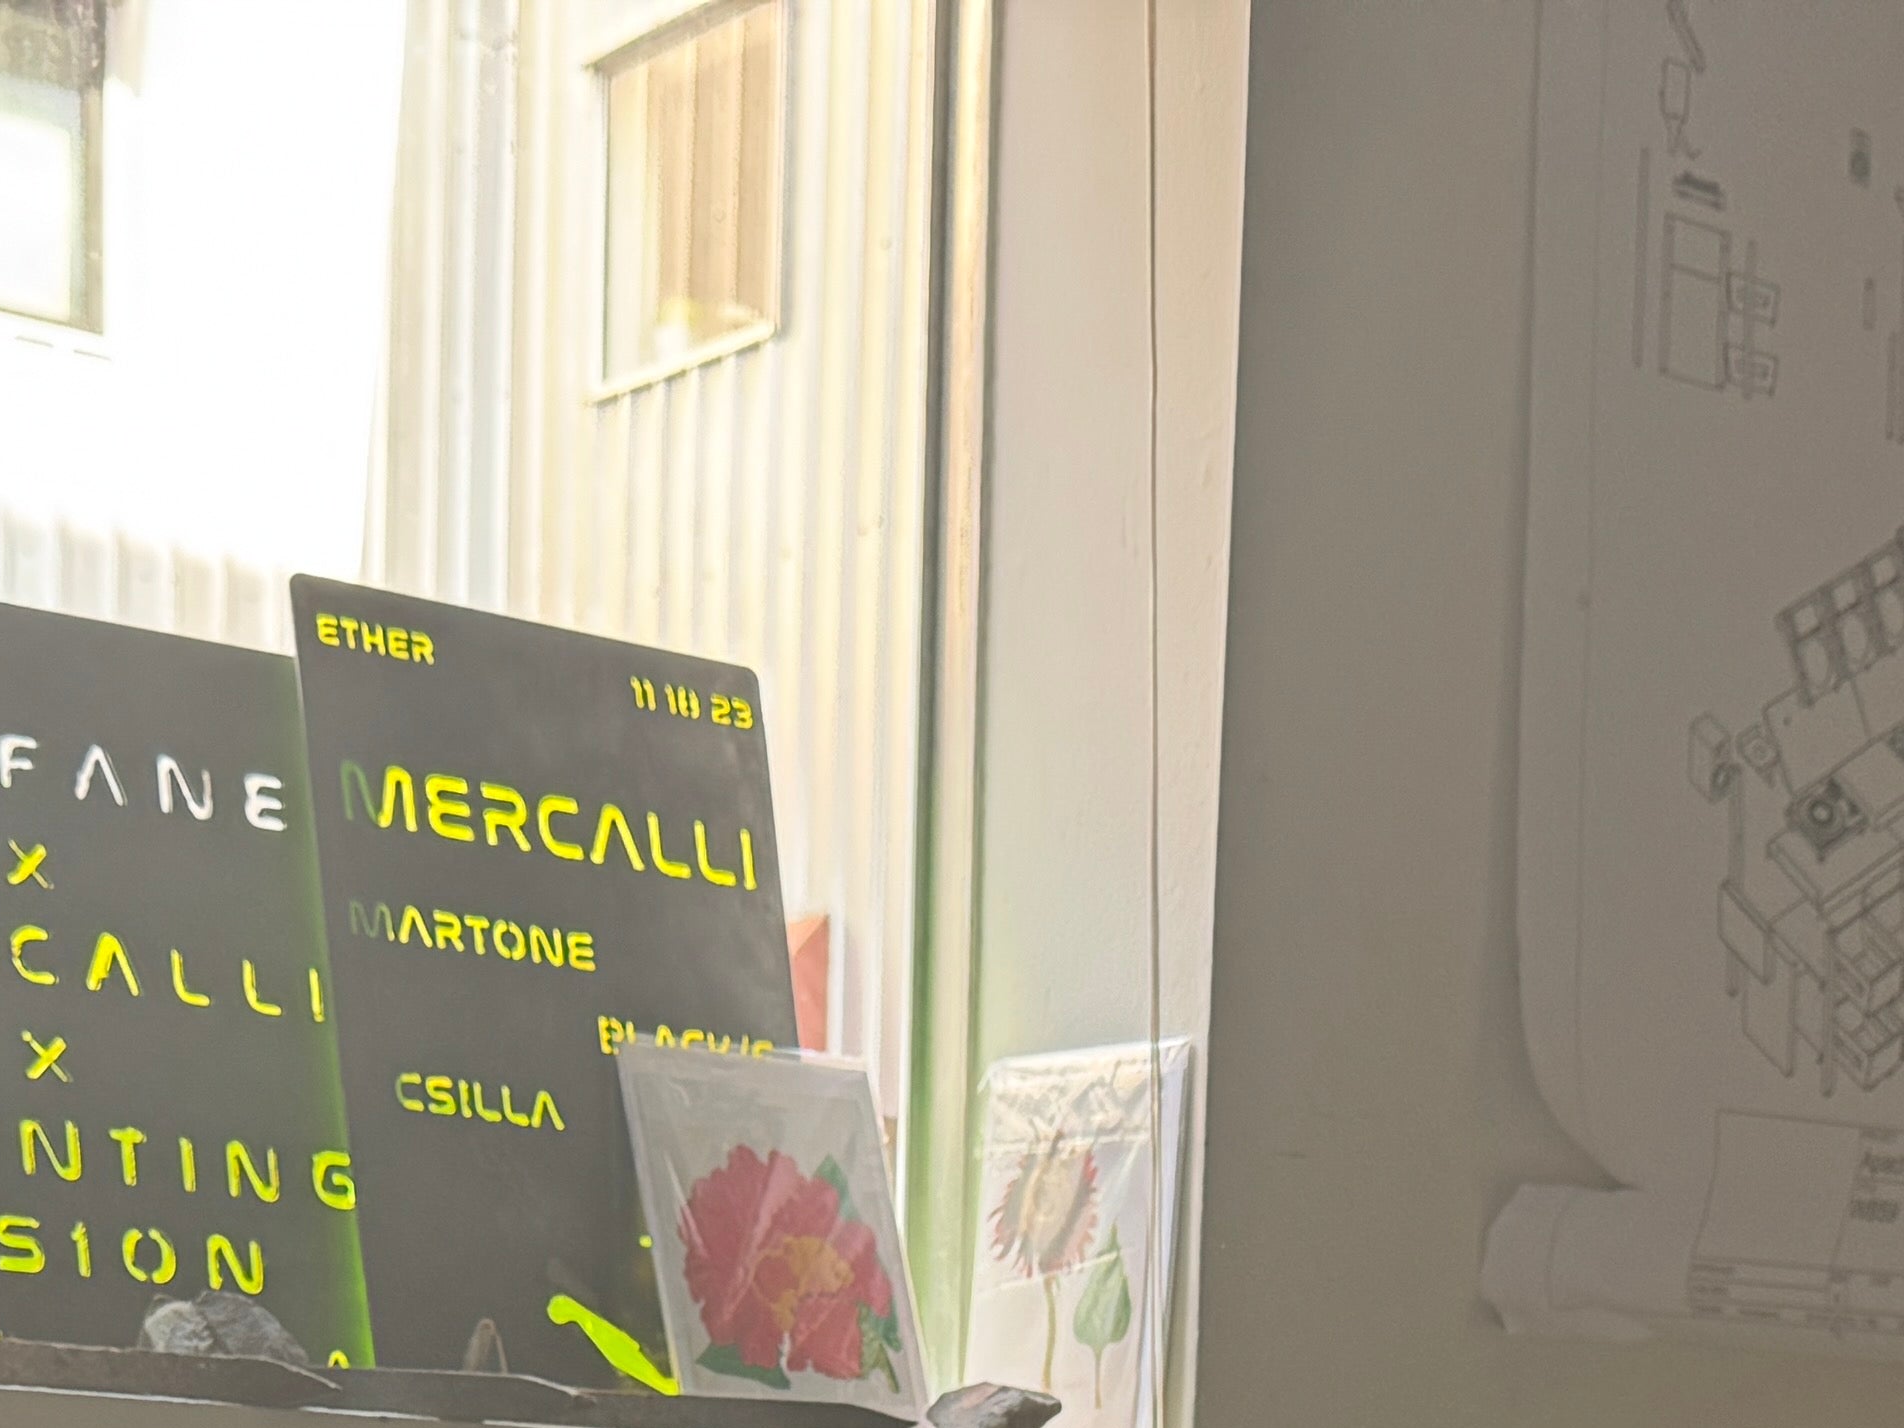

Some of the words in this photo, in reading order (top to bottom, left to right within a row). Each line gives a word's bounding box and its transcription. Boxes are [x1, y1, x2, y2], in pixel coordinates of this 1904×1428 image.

[315, 613, 436, 666] ETHER
[630, 675, 657, 712] 11
[710, 693, 753, 730] 23
[338, 764, 759, 892] MERCALLI
[349, 899, 598, 973] MARTONE
[395, 1071, 566, 1132] CSILLA
